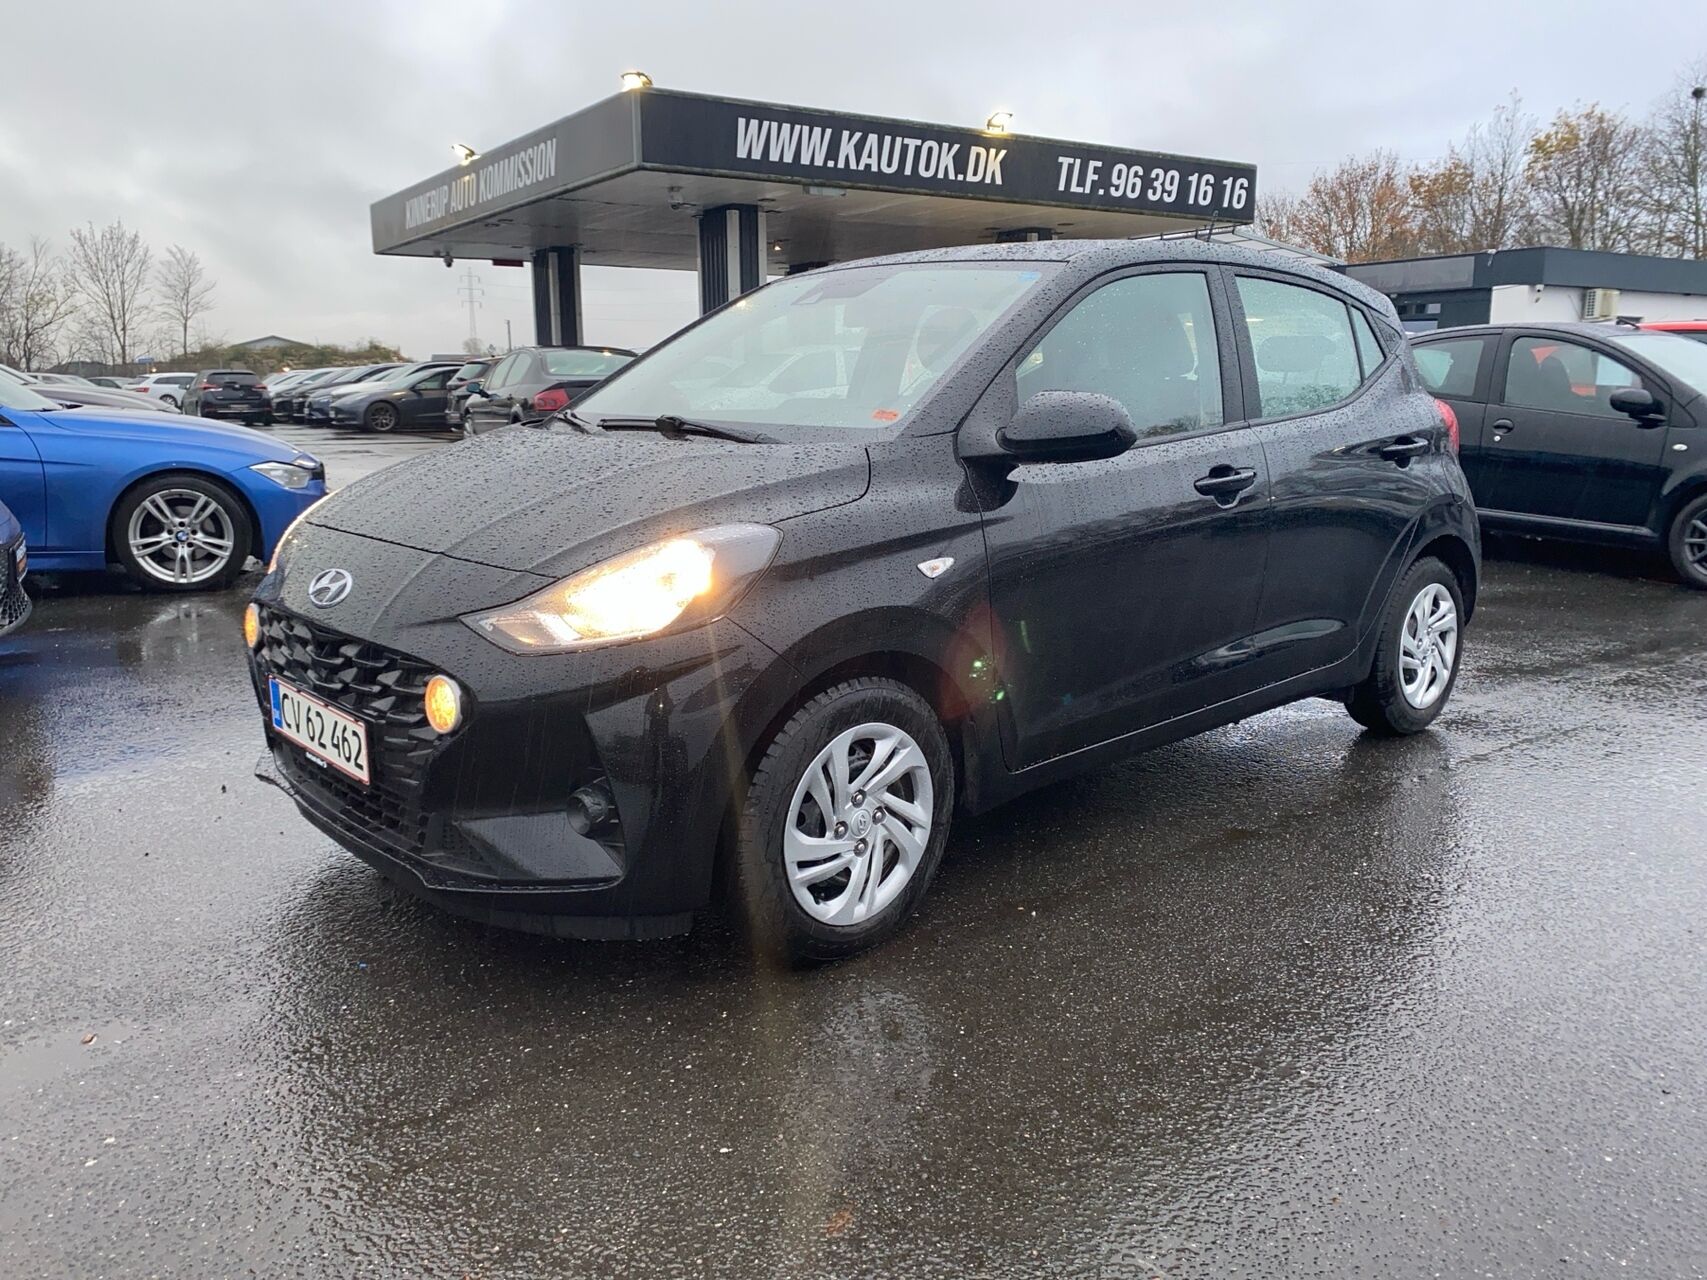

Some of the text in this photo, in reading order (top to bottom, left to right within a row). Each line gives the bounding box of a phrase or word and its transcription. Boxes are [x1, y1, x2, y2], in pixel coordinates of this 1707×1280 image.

[450, 173, 477, 213] AUTO
[479, 138, 557, 203] KOMMISSION
[736, 117, 1007, 185] WWW.KAUTOK.DK
[1057, 156, 1249, 209] TLF. 96 39 16 16
[281, 692, 364, 771] CV 62 462
